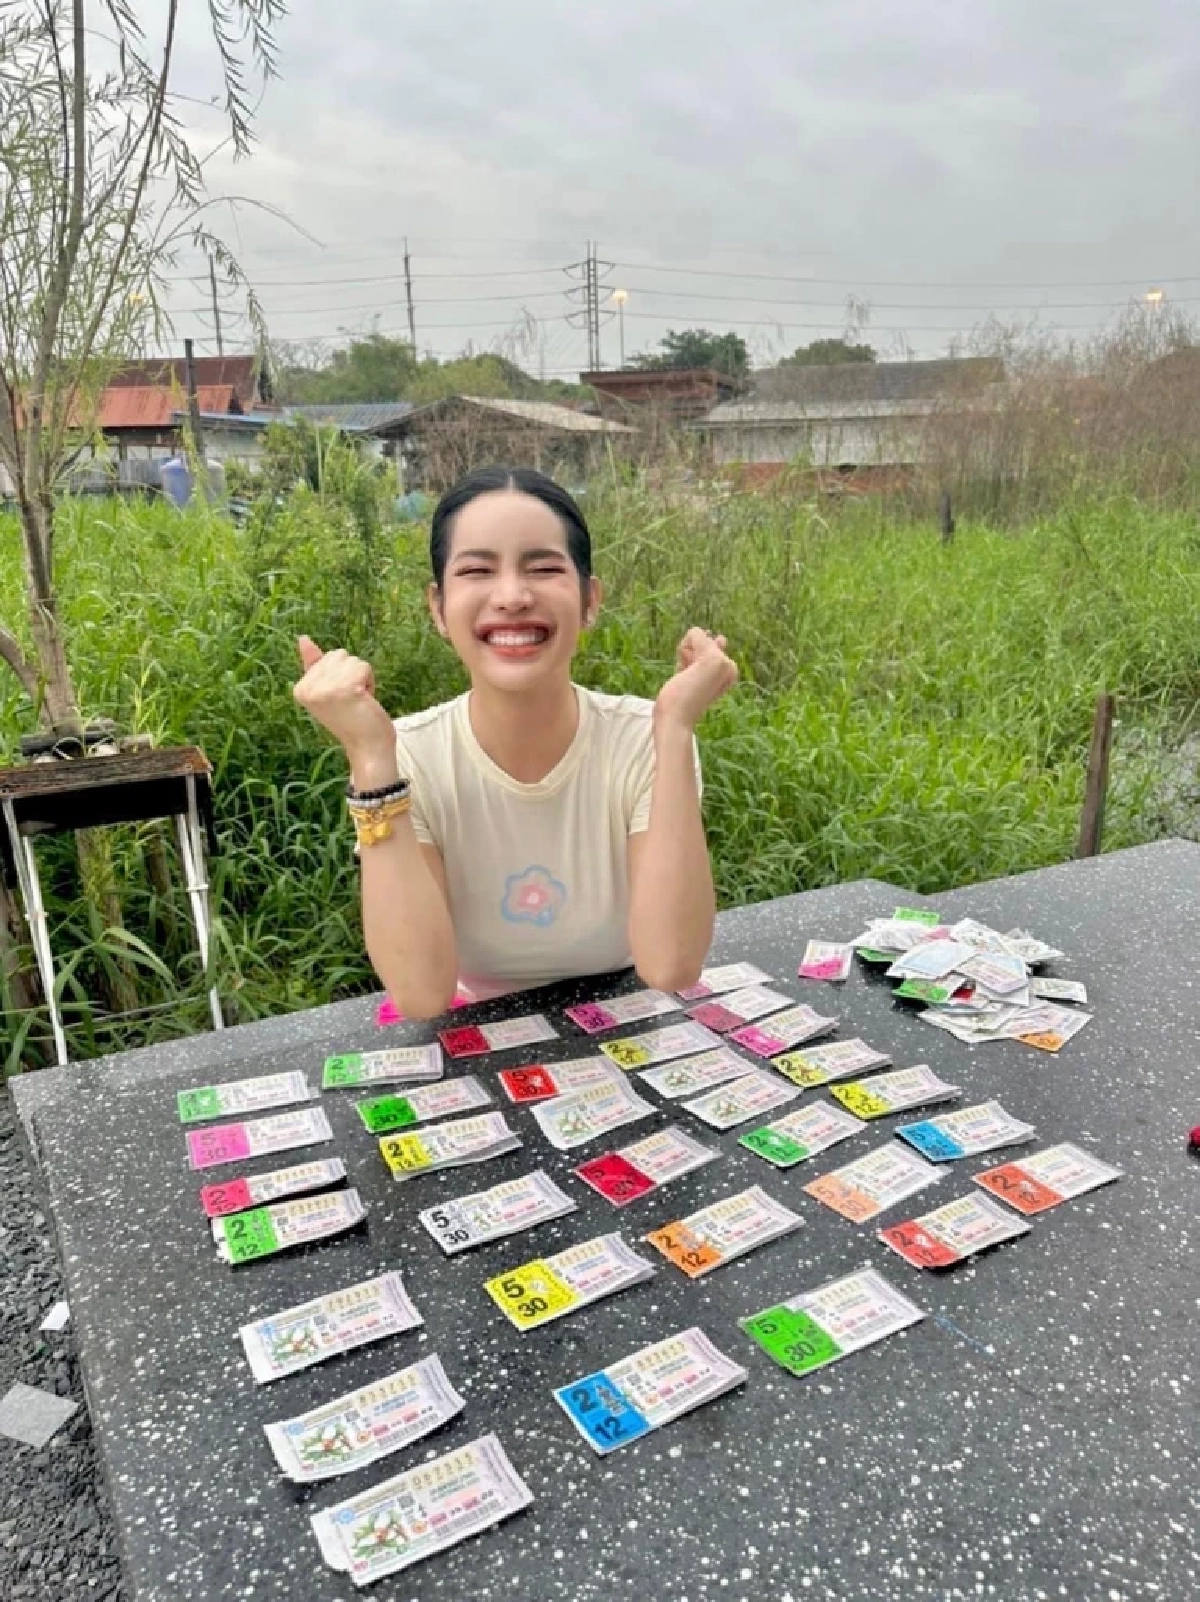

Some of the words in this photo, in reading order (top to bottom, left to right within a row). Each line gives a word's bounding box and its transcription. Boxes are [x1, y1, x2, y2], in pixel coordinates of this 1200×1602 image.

[331, 1059, 344, 1070] 2
[781, 1059, 796, 1072] 2
[512, 1071, 527, 1082] 5
[839, 1086, 855, 1101] 2
[202, 1133, 215, 1146] 5
[748, 1135, 769, 1148] 2
[388, 1142, 405, 1157] 2
[992, 1175, 1017, 1190] 2
[209, 1190, 228, 1206] 2
[815, 1185, 834, 1199] 5
[430, 1210, 450, 1229] 5
[231, 1219, 248, 1240] 2
[443, 1229, 470, 1245] 30
[658, 1235, 680, 1250] 2
[892, 1230, 916, 1248] 2
[236, 1243, 261, 1257] 12
[681, 1252, 708, 1268] 12
[501, 1277, 525, 1299] 5
[517, 1297, 549, 1317] 30
[755, 1318, 778, 1335] 5
[783, 1340, 816, 1362] 30
[571, 1388, 598, 1414] 2
[595, 1415, 628, 1440] 12
